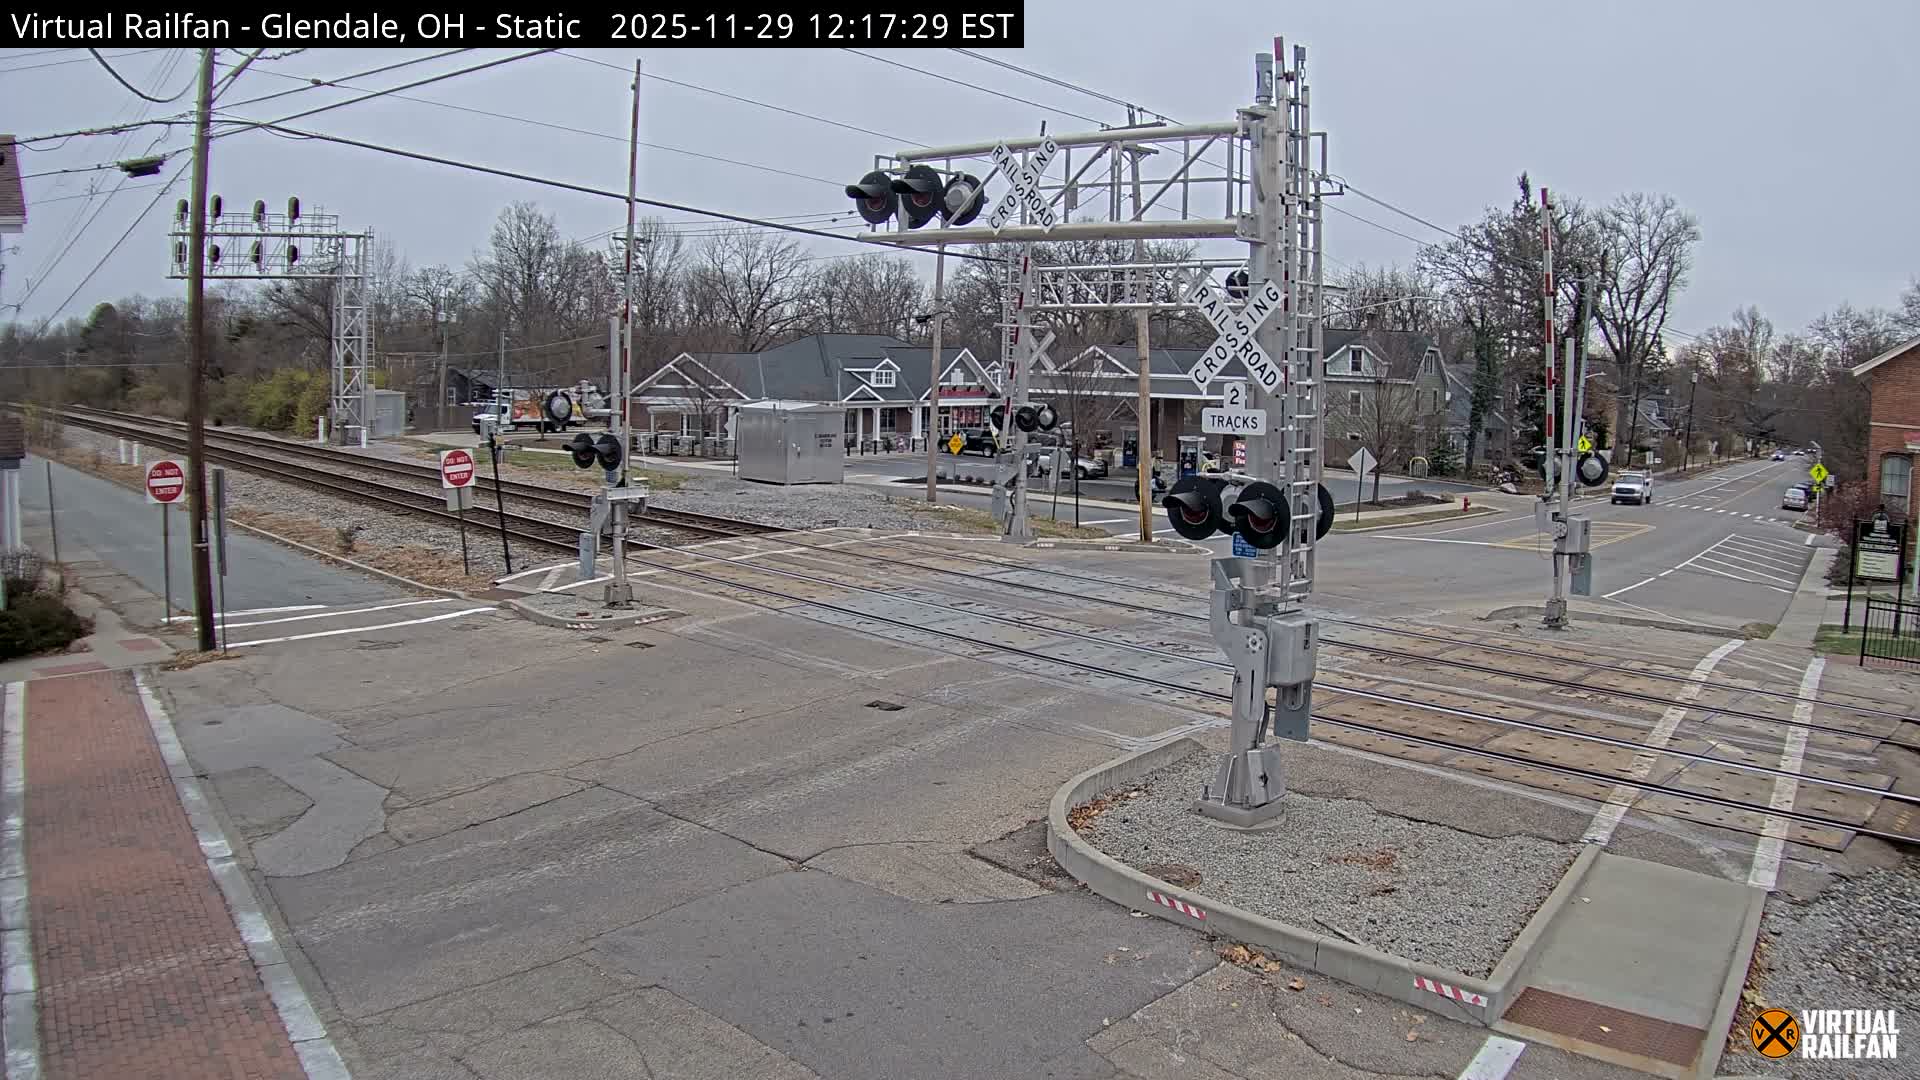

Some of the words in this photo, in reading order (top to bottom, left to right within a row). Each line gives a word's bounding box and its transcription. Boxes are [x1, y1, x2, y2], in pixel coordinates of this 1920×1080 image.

[991, 141, 1055, 229] CROSSING
[1194, 286, 1279, 384] CROSSING
[1230, 388, 1239, 405] 2
[1210, 415, 1258, 430] TRACKS
[450, 472, 468, 480] ENTER
[155, 487, 177, 495] ENTER
